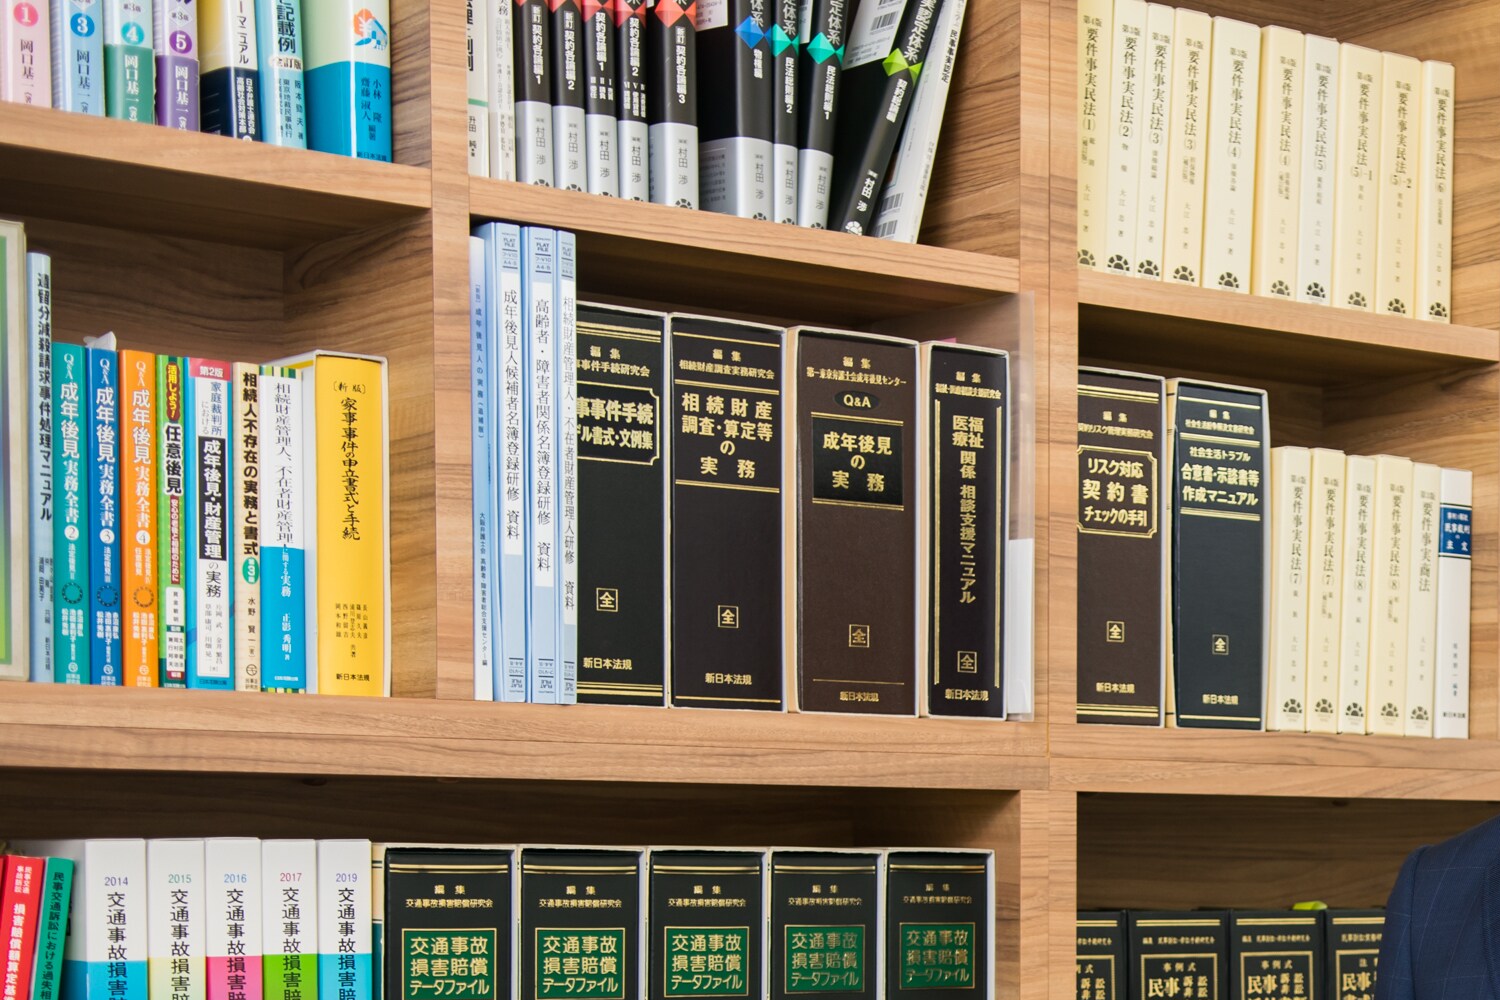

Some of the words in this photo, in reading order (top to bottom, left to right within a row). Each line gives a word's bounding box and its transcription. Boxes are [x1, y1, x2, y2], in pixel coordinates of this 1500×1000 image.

[176, 35, 187, 50] 5
[20, 39, 34, 87] 岡口基一
[77, 50, 91, 97] 岡口基一
[200, 366, 223, 377] 第2版
[679, 360, 775, 379] 相続財産調査実務研究会
[504, 290, 519, 500] 成年後見人候補者名簿登録研修
[843, 395, 872, 408] Q&A
[211, 382, 222, 435] 家庭裁判所
[535, 300, 550, 525] 高齢者・障害者関係名簿登録研修
[682, 392, 773, 420] 相続財産
[201, 400, 209, 434] における
[563, 297, 575, 564] 相続財産管理人・不在者財産管理人研修
[682, 415, 773, 442] 調査・算定等
[720, 440, 736, 455] の
[823, 431, 892, 455] 成年後見
[60, 383, 80, 525] 成年後見実務全書
[96, 387, 116, 526] 成年後見実務全書
[132, 389, 152, 528] 成年後見実務全書
[165, 424, 182, 495] 任意後見
[851, 455, 866, 470] の
[1189, 447, 1251, 462] 社会生活トラブル
[243, 372, 258, 556] 相続人不存在の実務と書式
[701, 456, 755, 479] 実務
[1088, 458, 1144, 478] リスク対応
[832, 471, 885, 492] 実務
[1181, 463, 1259, 487] 合意書・示談書等
[204, 440, 223, 559] 成年後見・財産管理
[1083, 479, 1148, 504] 契約書
[1182, 486, 1258, 506] 作成マニュアル
[507, 510, 520, 540] 資料
[1084, 506, 1147, 527] チェックの手引
[537, 542, 550, 571] 資料
[206, 562, 222, 598] の実務
[583, 658, 632, 671] 新日本法規
[336, 673, 369, 682] 新日本法規
[705, 673, 752, 685] 新日本法規
[104, 876, 129, 886] 2014
[168, 874, 192, 883] 2015
[224, 874, 247, 883] 2016
[280, 873, 302, 882] 2017
[335, 873, 358, 882] 2019
[410, 937, 489, 956] 交通事故
[543, 936, 617, 954] 交通事故
[672, 934, 741, 952] 交通事故
[792, 932, 858, 950] 交通事故
[410, 958, 489, 977] 損害賠償
[543, 956, 617, 975] 損害賠償
[672, 955, 741, 973] 損害賠償
[792, 952, 858, 970] 損害賠償
[1163, 962, 1196, 973] 事例式
[1261, 959, 1293, 970] 事例式
[410, 979, 490, 996] データファイル
[542, 977, 618, 993] データファイル
[671, 975, 743, 990] データファイル
[1148, 977, 1180, 998] 民事
[1247, 974, 1278, 995] 民事
